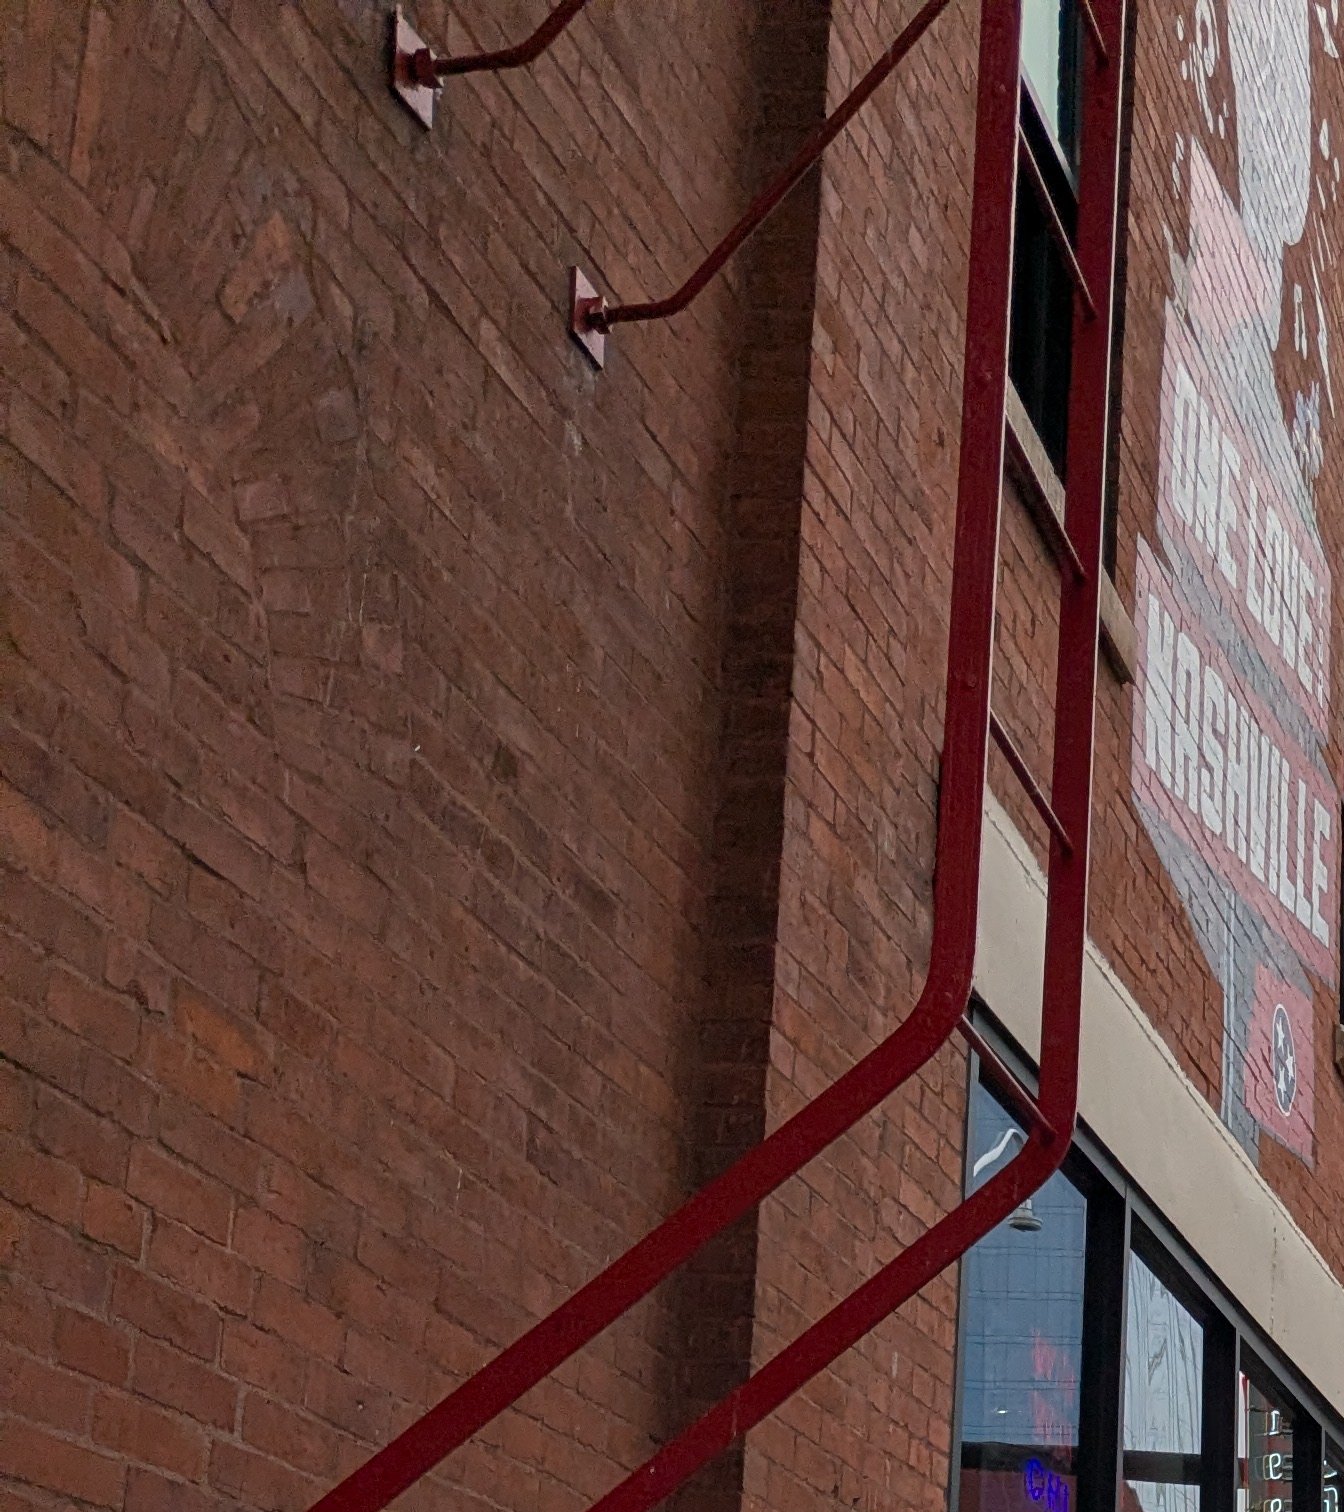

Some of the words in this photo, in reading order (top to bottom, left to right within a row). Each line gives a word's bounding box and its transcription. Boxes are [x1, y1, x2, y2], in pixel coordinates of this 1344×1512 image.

[1171, 362, 1241, 589] ONE
[1246, 475, 1316, 695] LOVE
[1145, 593, 1331, 949] NASHVILLE
